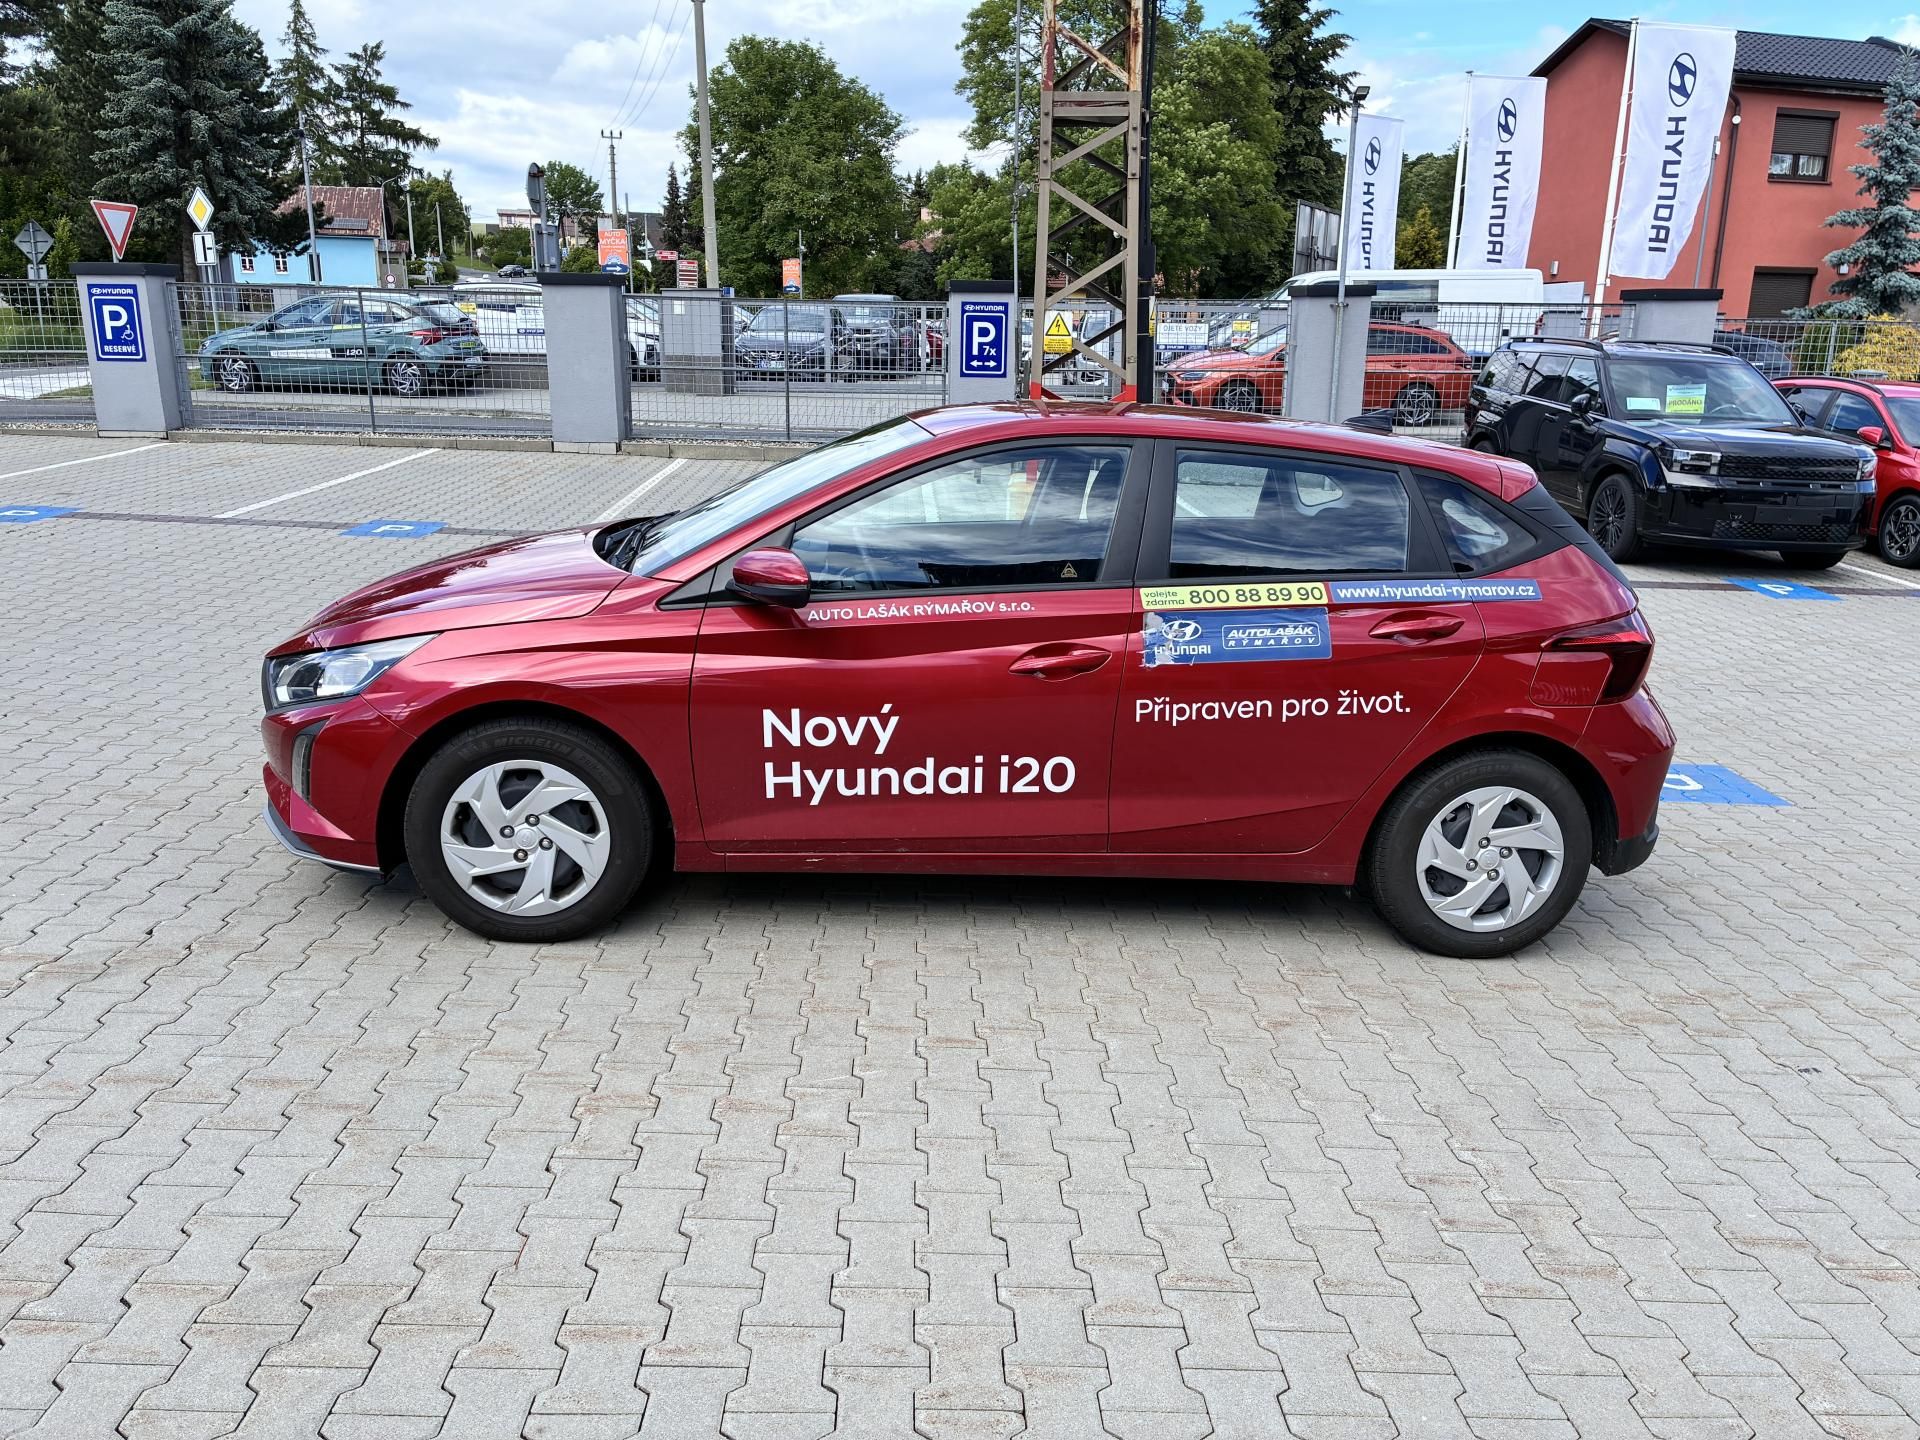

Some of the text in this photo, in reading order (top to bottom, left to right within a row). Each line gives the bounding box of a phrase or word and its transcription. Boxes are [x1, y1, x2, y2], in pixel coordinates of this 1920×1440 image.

[1647, 115, 1688, 254] HYUNDAI
[1486, 150, 1513, 264] HYUNDAI
[1361, 181, 1375, 270] HYUNDA
[101, 304, 128, 340] P
[972, 321, 996, 355] P
[104, 343, 137, 353] RESERVÉ
[982, 345, 997, 356] 7x
[1668, 398, 1703, 407] PRODÁNO
[370, 524, 415, 533] P
[1143, 589, 1178, 599] volejte
[1189, 586, 1323, 604] 800 88 89 90
[1336, 583, 1536, 600] www.hyundai-rymarov.cz
[807, 599, 1035, 621] AUTO LAŠÁK RÝMAŘOV s.r.o.
[1145, 598, 1185, 607] zdarma
[1227, 624, 1315, 638] AUTOLAŠÁK
[1154, 644, 1211, 655] HUNDAI
[1228, 636, 1316, 647] RÝMAŘOV
[1135, 689, 1411, 727] Připraven pro život.
[762, 703, 900, 755] Nový
[494, 735, 575, 755] MICHELIN
[764, 754, 1076, 806] Hyundai i20
